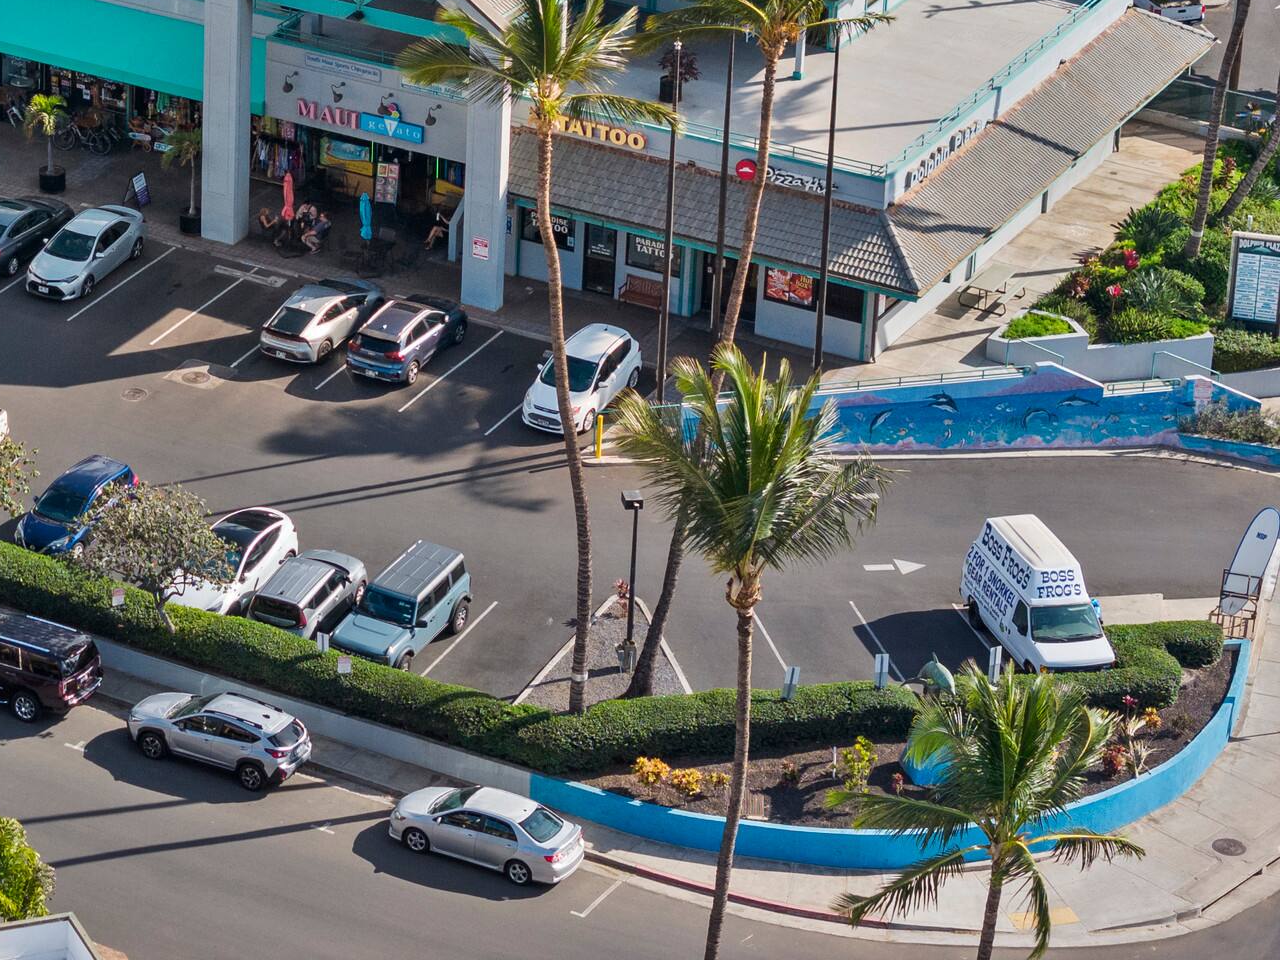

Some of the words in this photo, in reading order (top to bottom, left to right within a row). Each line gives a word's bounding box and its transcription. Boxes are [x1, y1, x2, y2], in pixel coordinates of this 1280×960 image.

[297, 98, 359, 129] MAUI
[557, 115, 646, 150] TATTOO
[911, 146, 950, 187] Dolphin
[766, 167, 802, 187] Pizza
[531, 211, 568, 225] PDISE
[636, 237, 665, 249] PARADI
[1240, 239, 1265, 248] DOLPHIN
[1266, 241, 1280, 252] PLAZ
[967, 546, 974, 558] 2
[971, 550, 986, 571] FOR
[988, 570, 1016, 608] SNORKEL
[1041, 569, 1075, 583] BOSS
[967, 562, 983, 587] GEAR
[981, 581, 1008, 616] RENTALS
[1037, 583, 1081, 599] FROG'S
